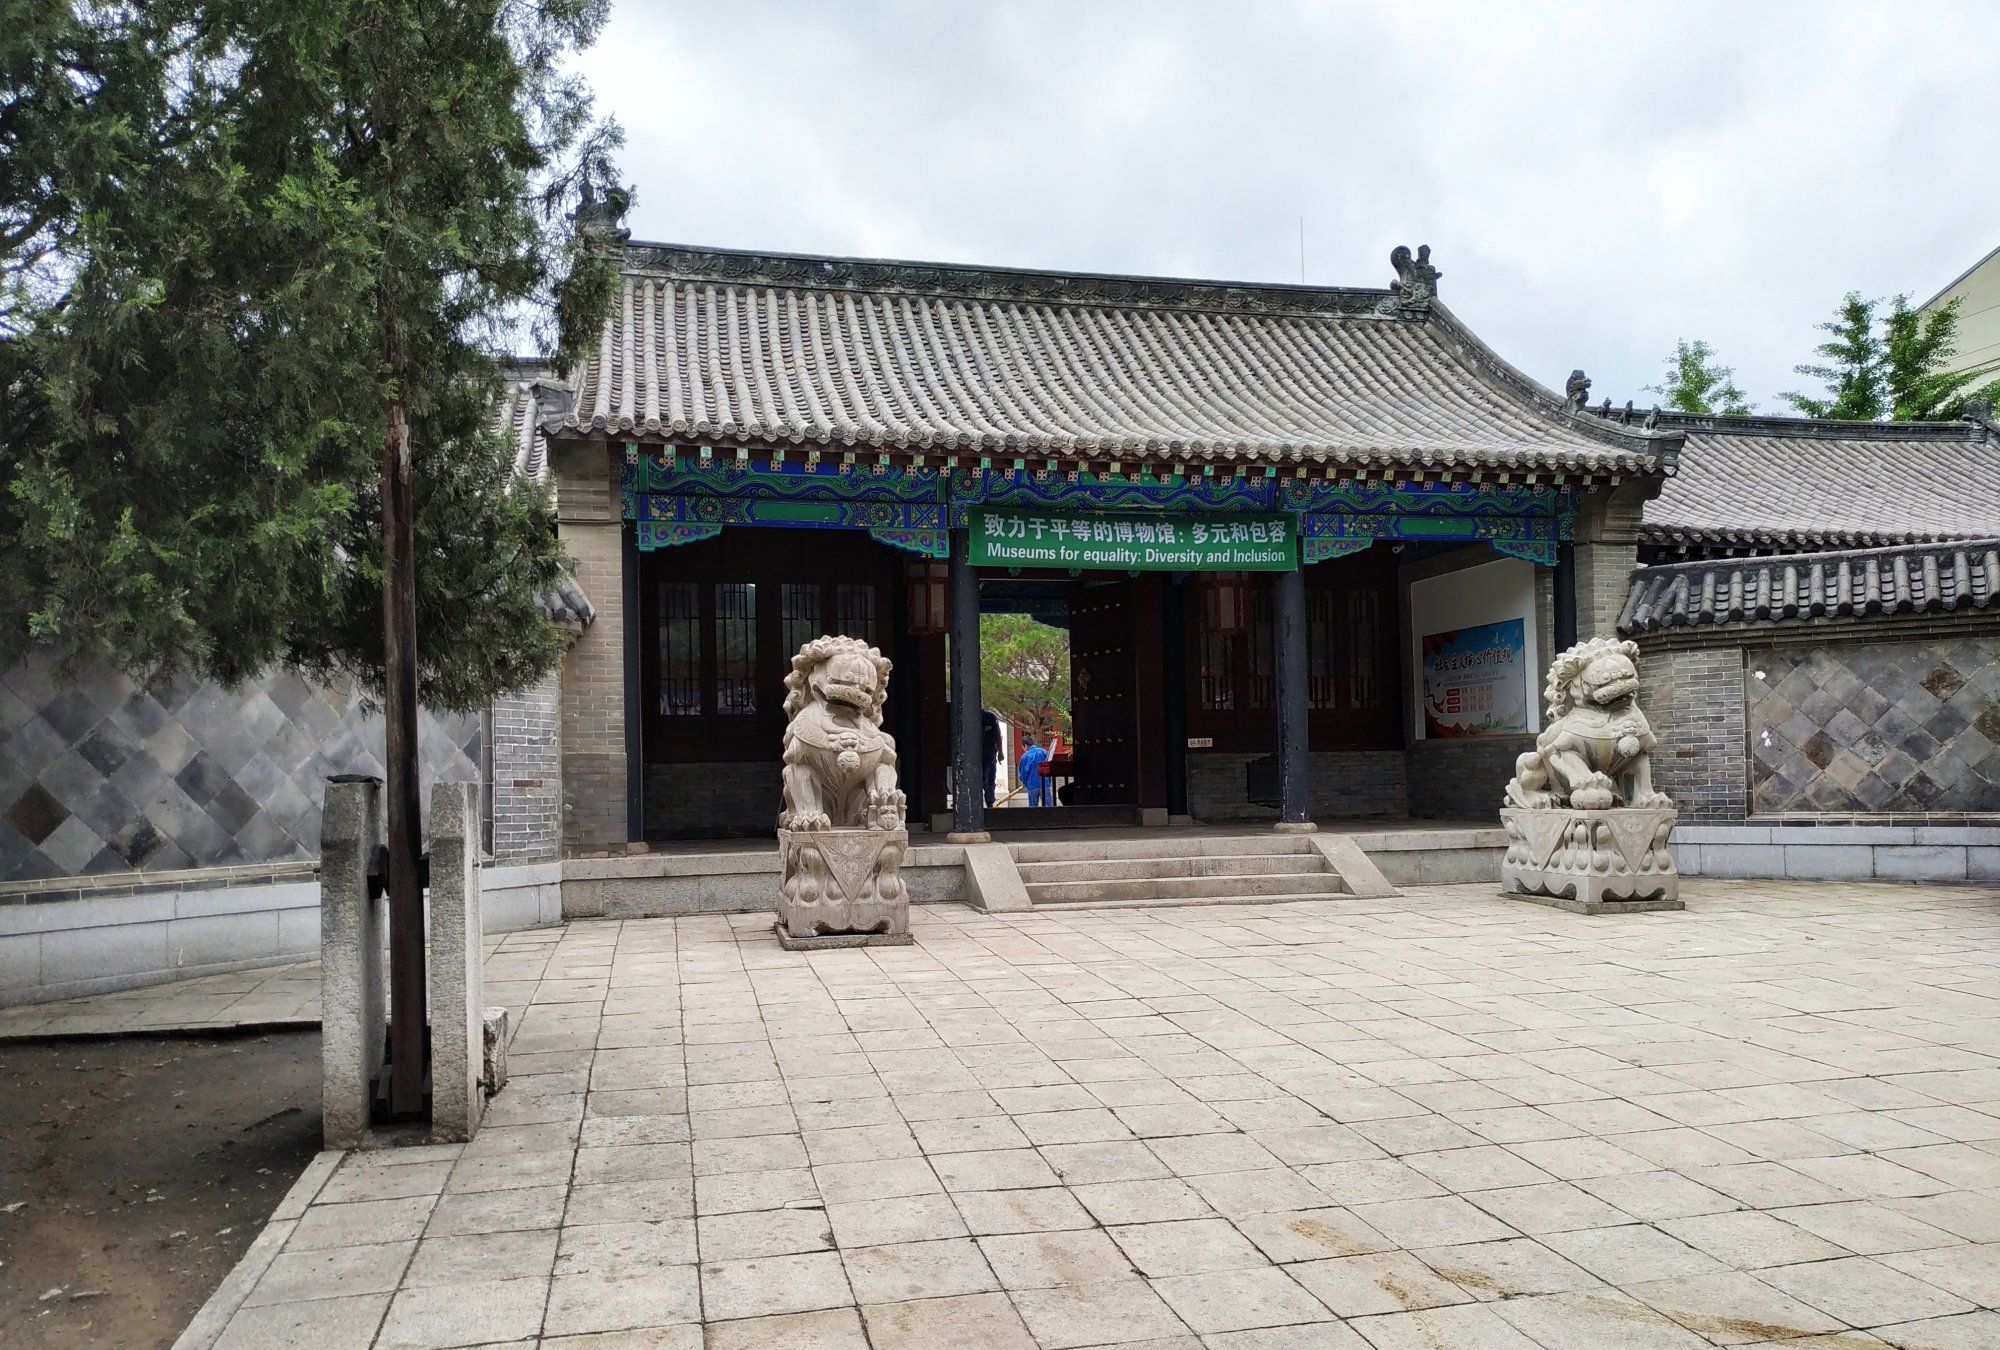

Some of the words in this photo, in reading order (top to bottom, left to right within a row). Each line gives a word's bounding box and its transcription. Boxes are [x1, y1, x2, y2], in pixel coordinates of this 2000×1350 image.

[987, 542, 1056, 560] Museums
[1059, 546, 1080, 561] for
[1083, 548, 1141, 564] equality:
[1145, 548, 1202, 565] Diversity
[1206, 549, 1230, 563] and
[1233, 549, 1286, 563] Inclusion
